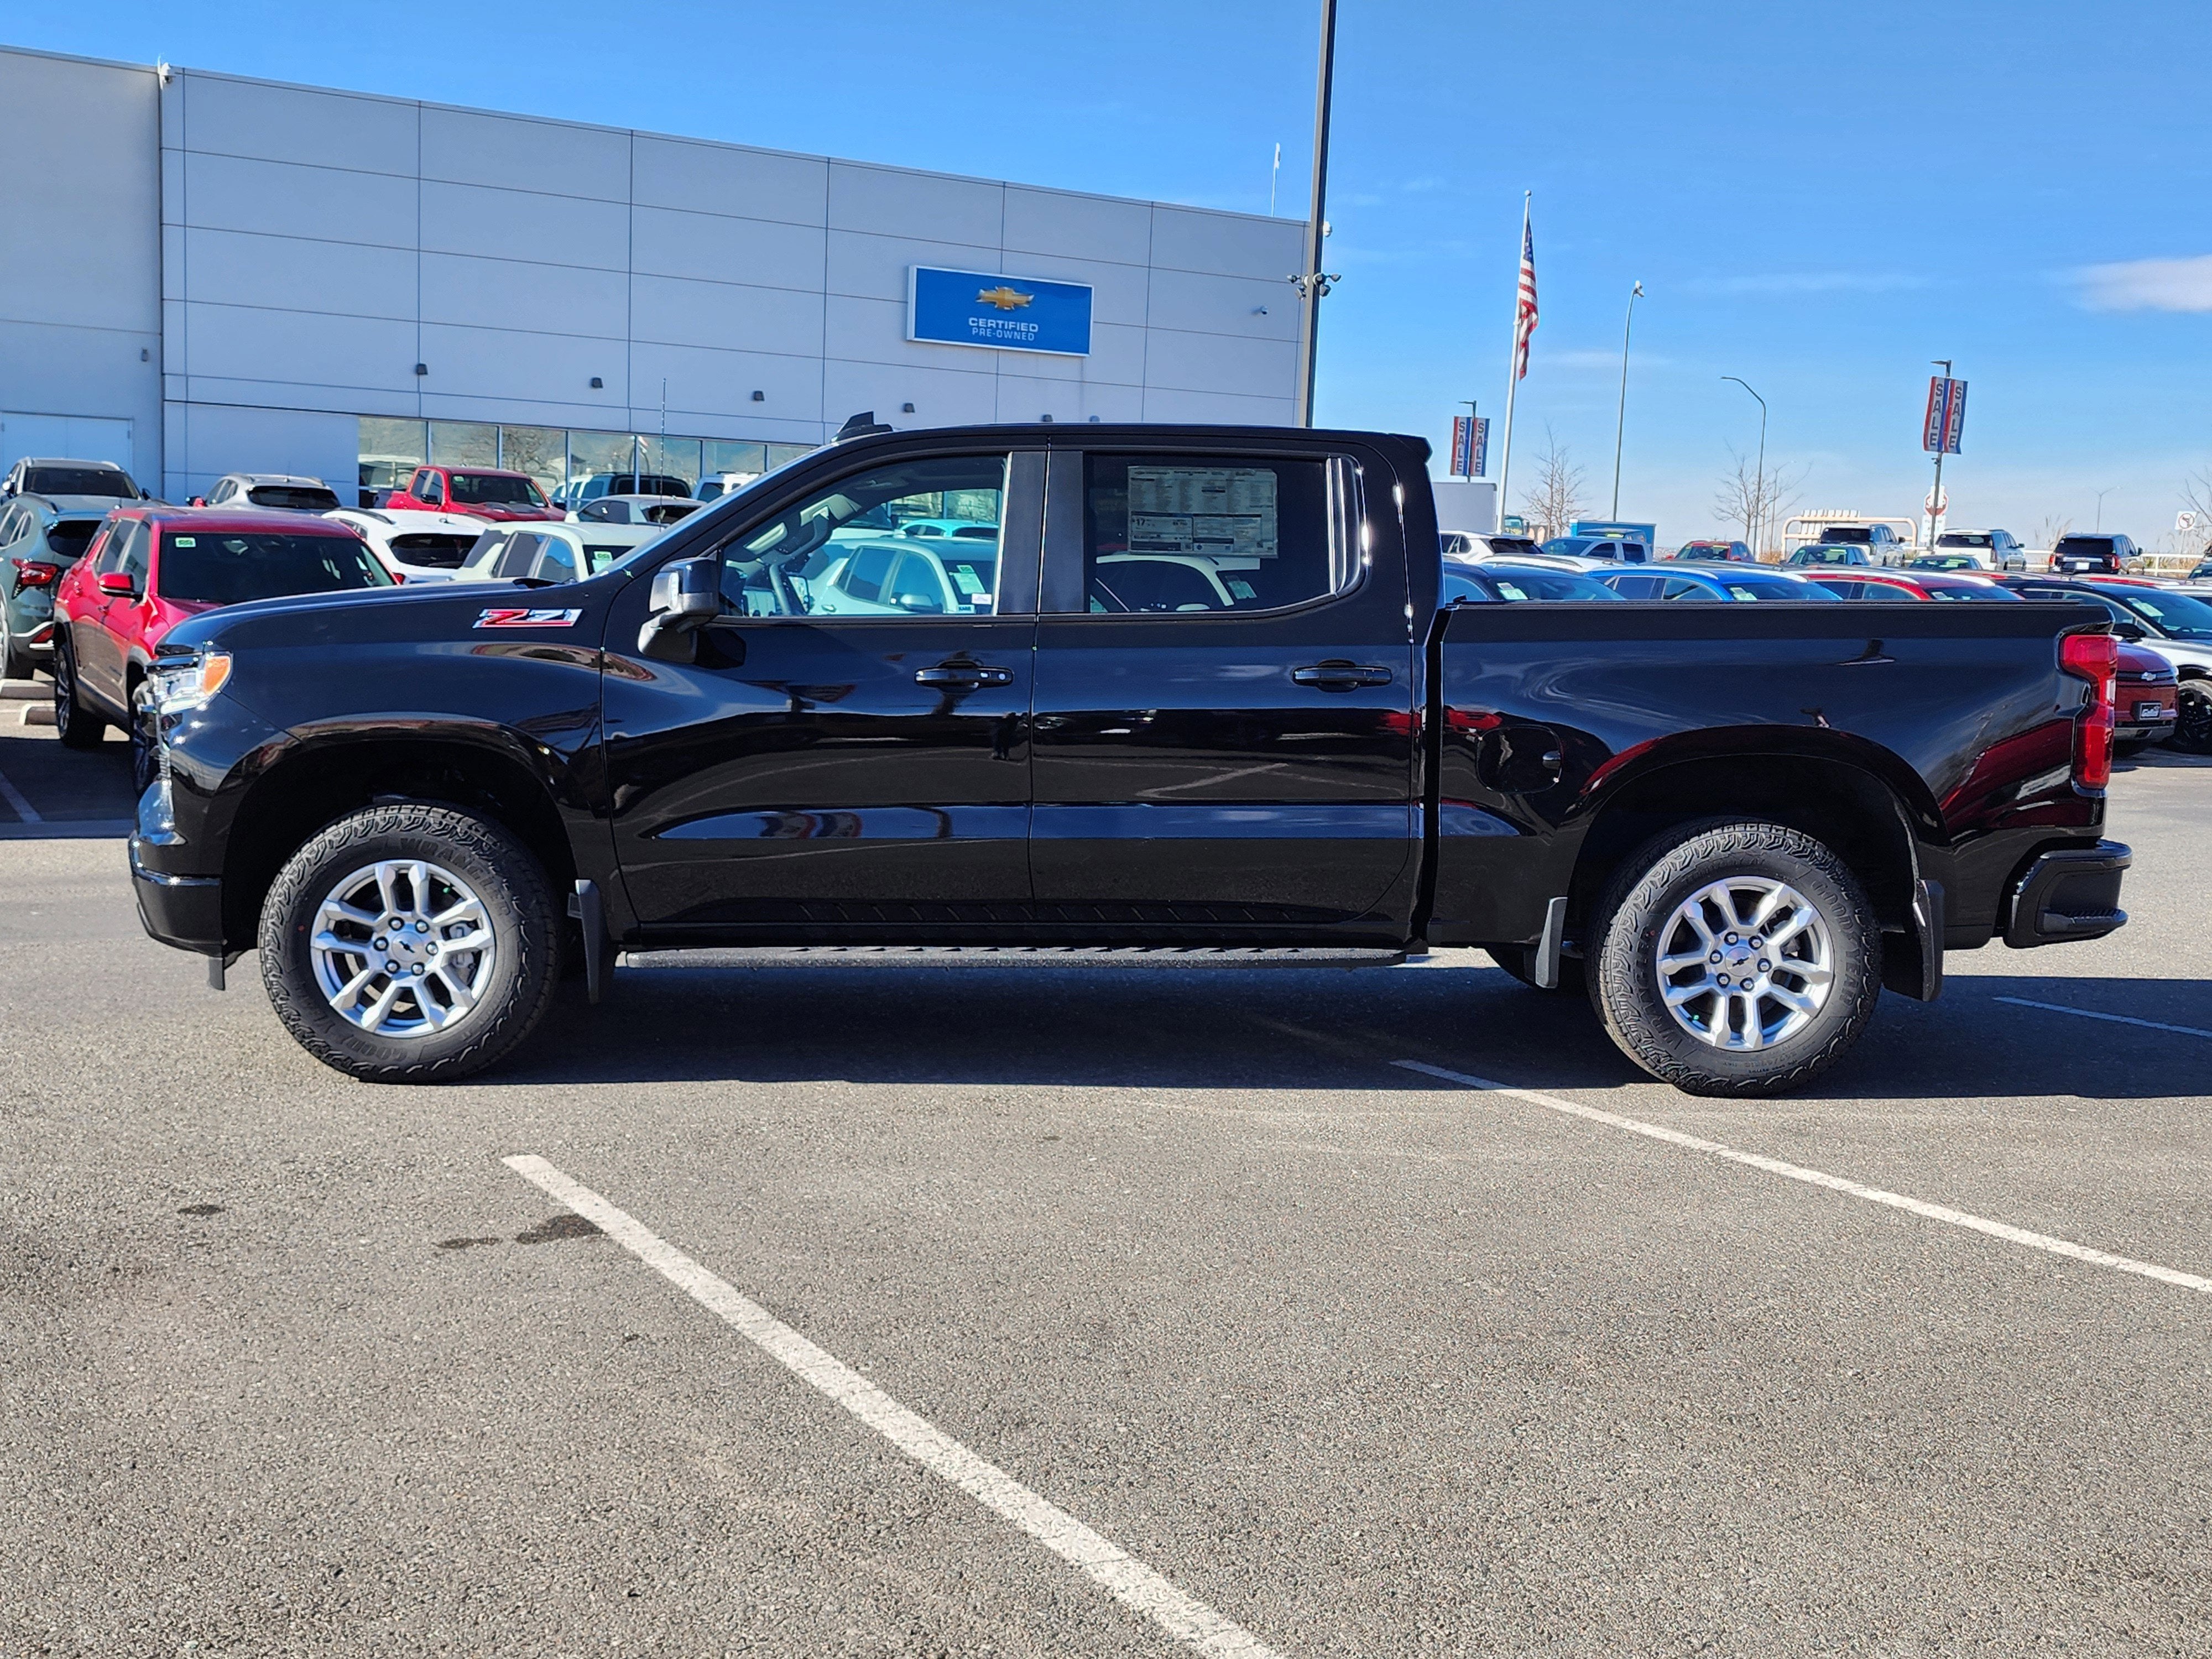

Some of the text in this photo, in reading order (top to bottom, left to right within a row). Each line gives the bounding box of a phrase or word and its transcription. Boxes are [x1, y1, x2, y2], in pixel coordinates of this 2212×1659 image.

[968, 317, 1039, 332] CERTIFIED
[972, 327, 1035, 341] PRE-OWNED
[1929, 383, 1943, 446] SALE
[1948, 386, 1963, 448] SALE
[1456, 421, 1465, 471] SALE
[1475, 422, 1485, 472] SALE
[472, 608, 583, 628] Z71
[400, 837, 511, 916] WRANGLER
[1812, 880, 1861, 1006] GOODYEAR
